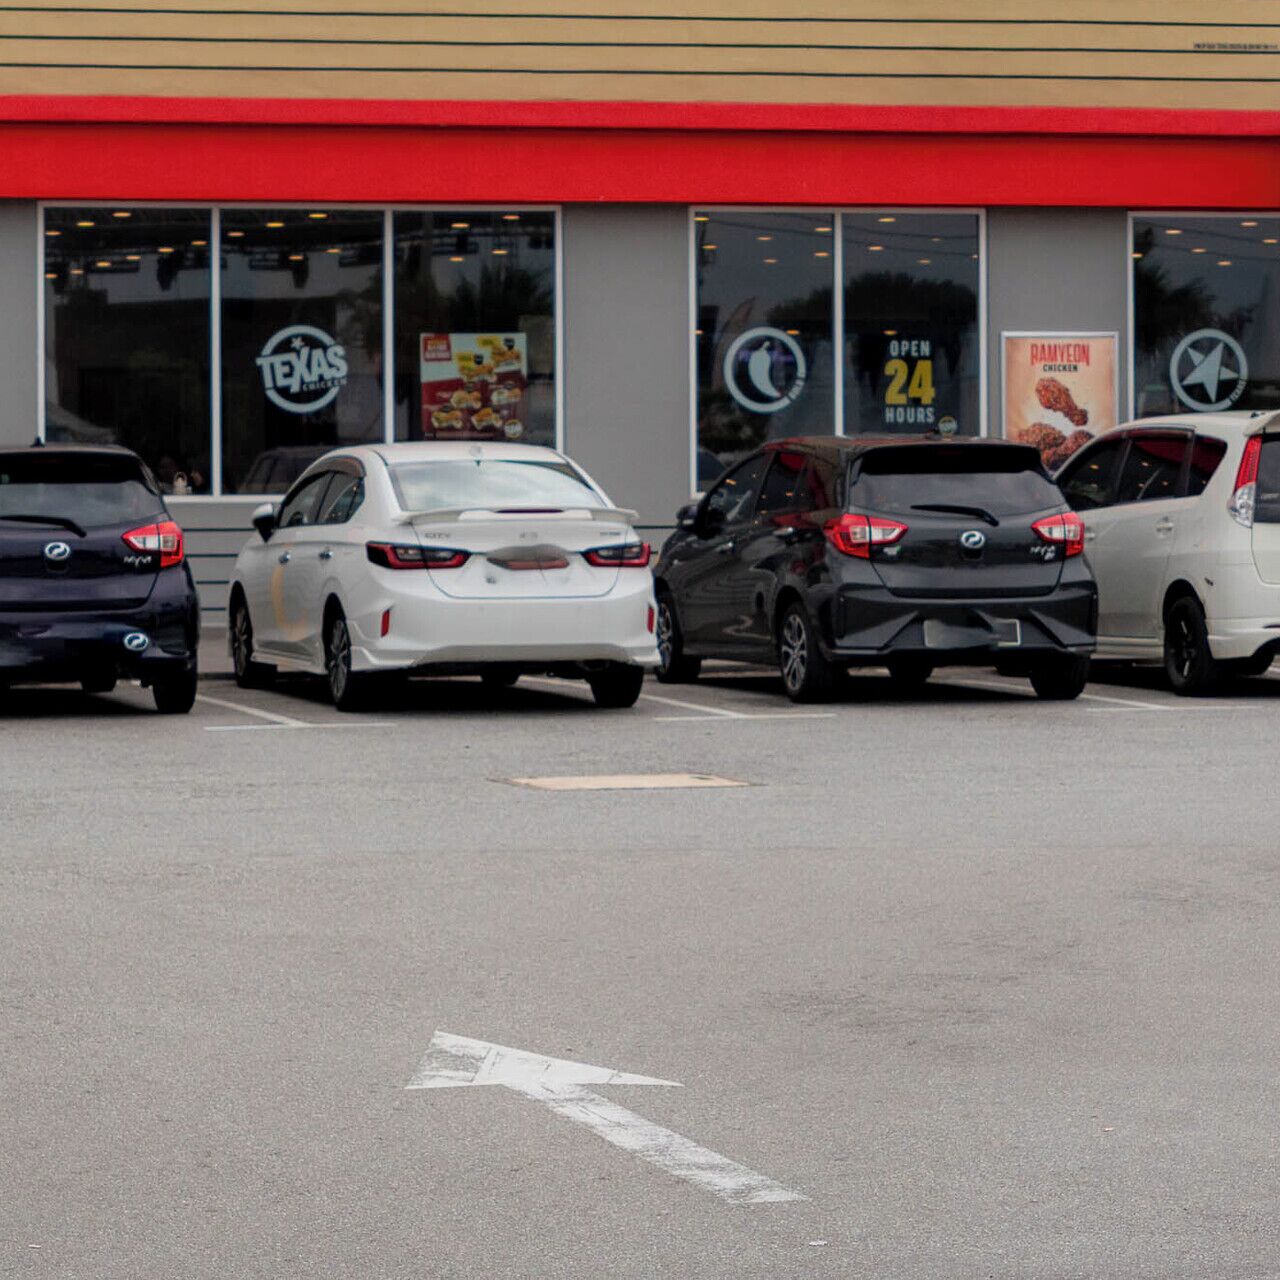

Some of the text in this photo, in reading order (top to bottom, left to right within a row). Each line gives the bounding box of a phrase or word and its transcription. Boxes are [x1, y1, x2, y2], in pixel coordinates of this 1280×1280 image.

[889, 340, 930, 357] OPEN
[1031, 343, 1090, 366] RAMYEON
[256, 344, 348, 394] TEXAS
[1043, 364, 1078, 372] CHICKEN
[884, 358, 935, 405] 24
[885, 406, 935, 423] HOURS
